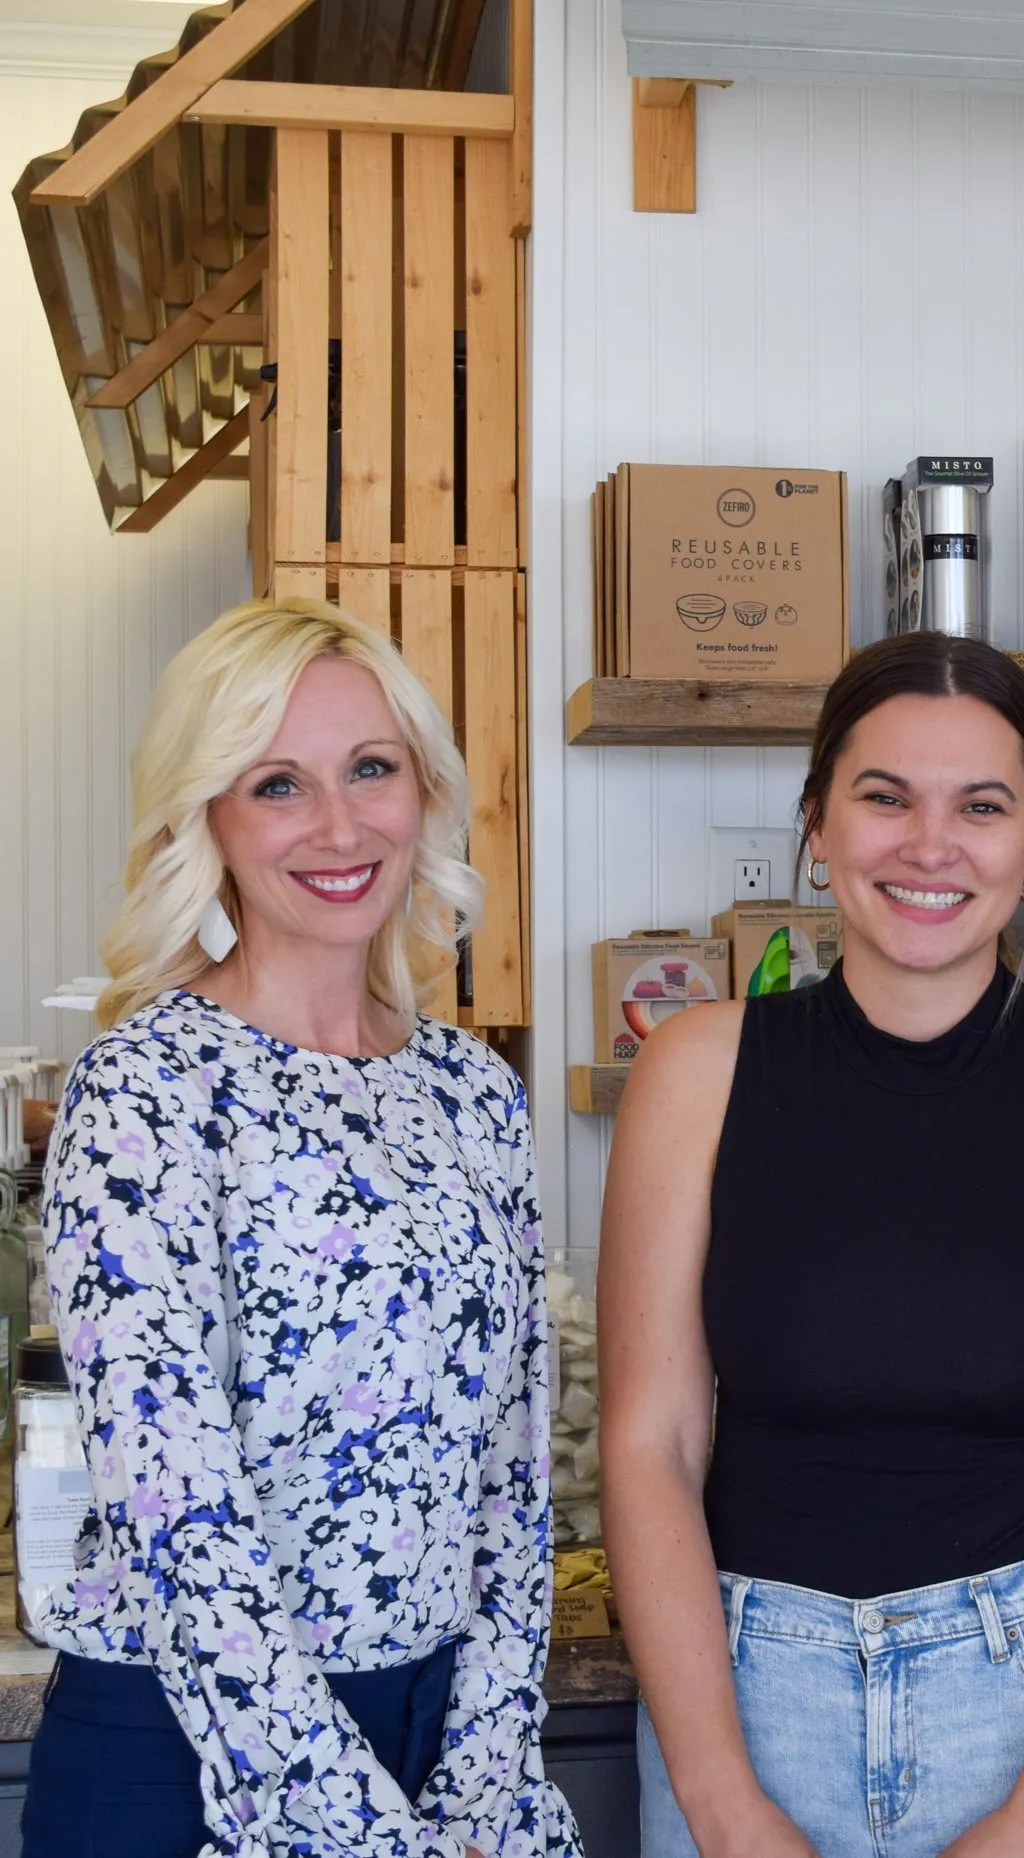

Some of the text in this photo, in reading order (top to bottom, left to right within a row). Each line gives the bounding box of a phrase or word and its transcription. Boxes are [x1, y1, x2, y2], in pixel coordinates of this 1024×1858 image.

[931, 461, 982, 470] MISTO
[722, 501, 750, 512] ZEFIRO
[671, 539, 800, 556] REUSABLE
[671, 557, 802, 571] FOOD COVERS
[696, 643, 778, 653] Keeps food fresh!
